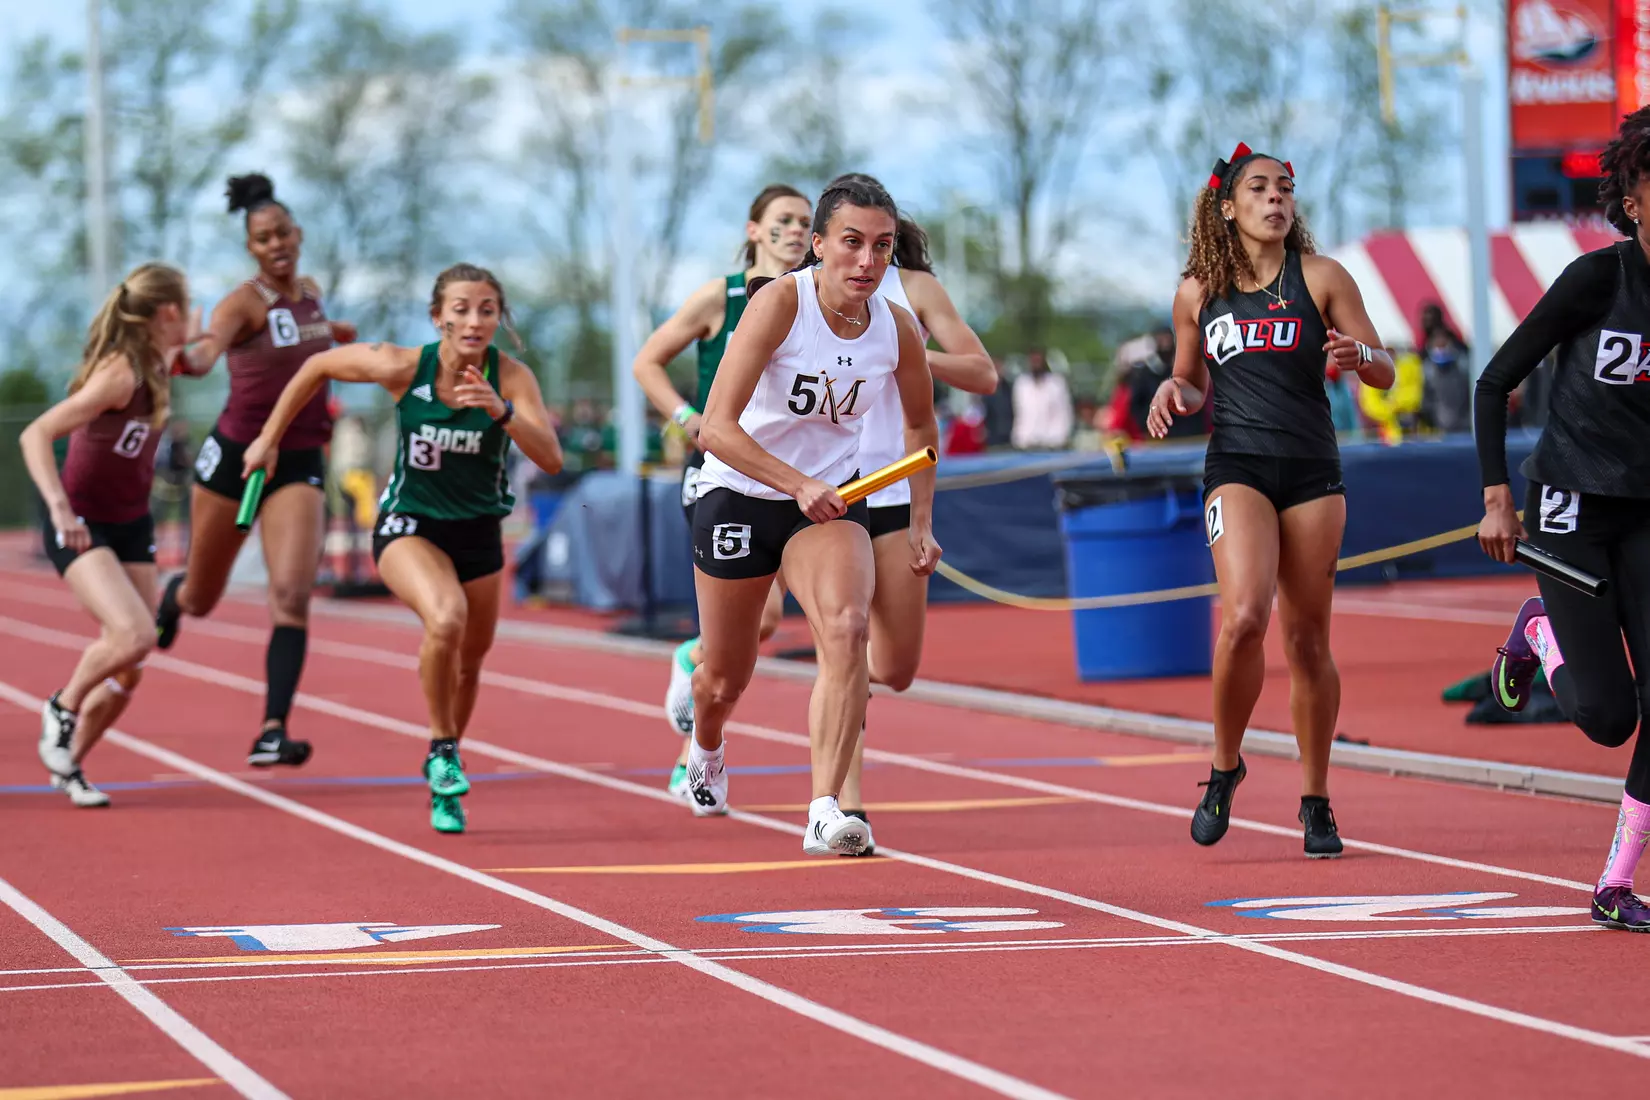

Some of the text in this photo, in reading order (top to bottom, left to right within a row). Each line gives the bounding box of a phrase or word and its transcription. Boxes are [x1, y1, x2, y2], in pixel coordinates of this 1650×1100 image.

[275, 314, 296, 341] 6
[1209, 320, 1237, 360] 2
[1600, 336, 1633, 382] 2
[788, 373, 819, 416] 5
[122, 426, 144, 454] 6
[413, 440, 435, 467] 3
[1207, 504, 1221, 539] 2
[1544, 485, 1572, 530] 2
[716, 525, 745, 556] 5
